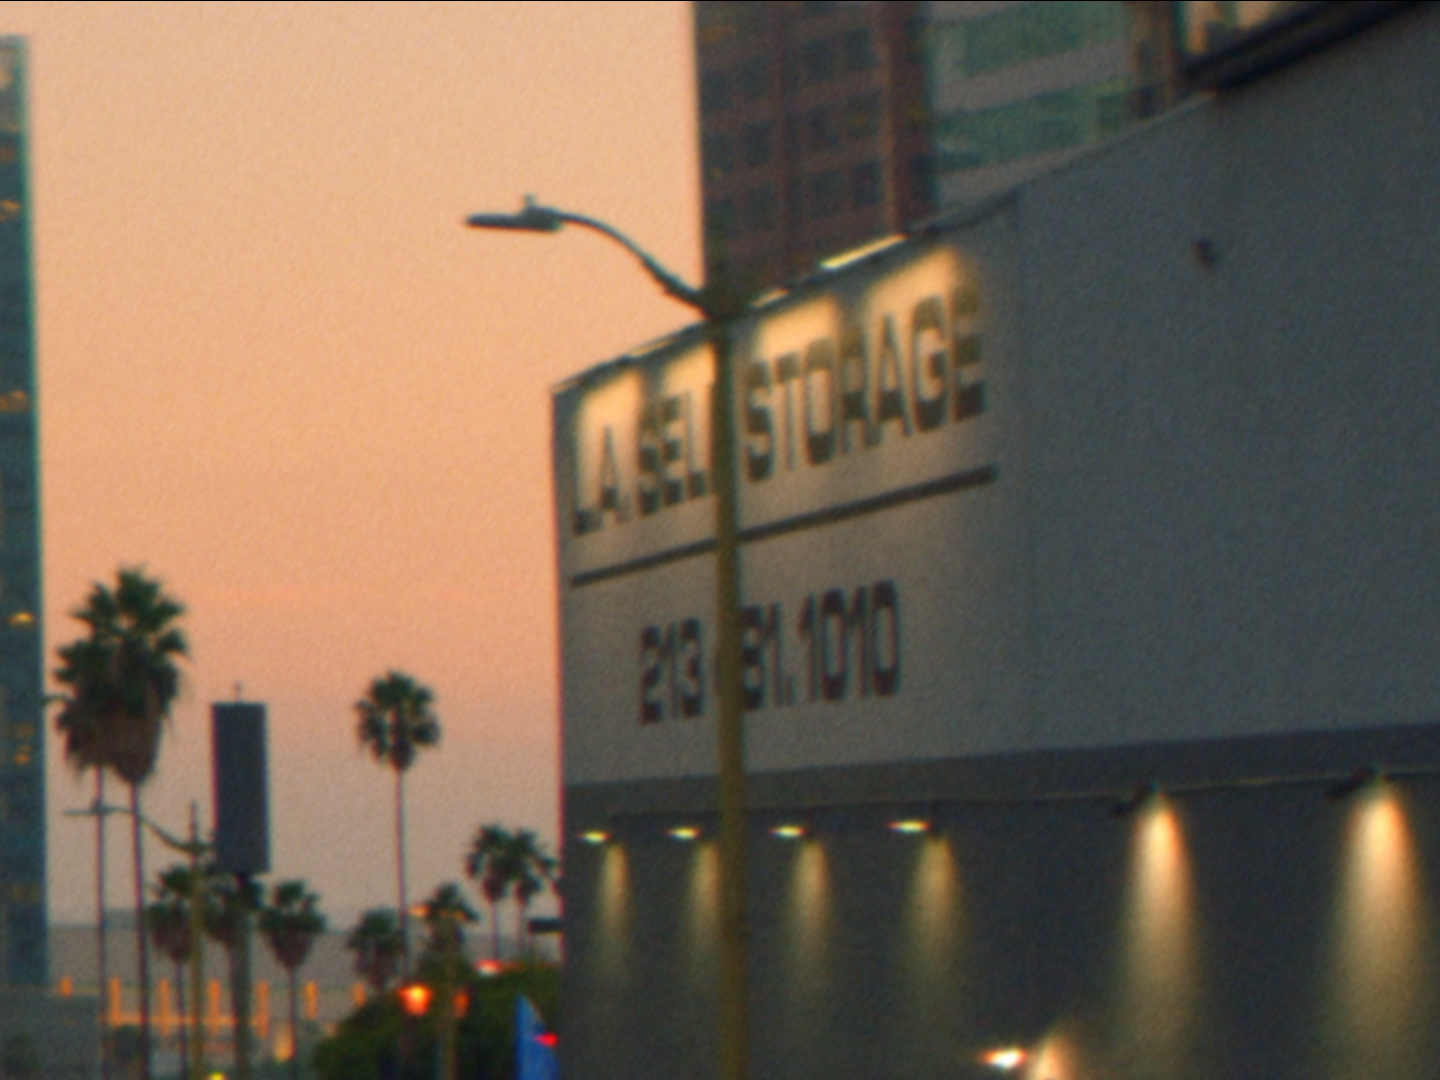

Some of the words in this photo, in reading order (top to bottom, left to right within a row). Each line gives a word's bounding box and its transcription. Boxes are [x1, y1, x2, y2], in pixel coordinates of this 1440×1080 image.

[637, 388, 716, 518] SEL
[744, 288, 988, 485] STORAGE
[714, 579, 901, 712] 81.1010
